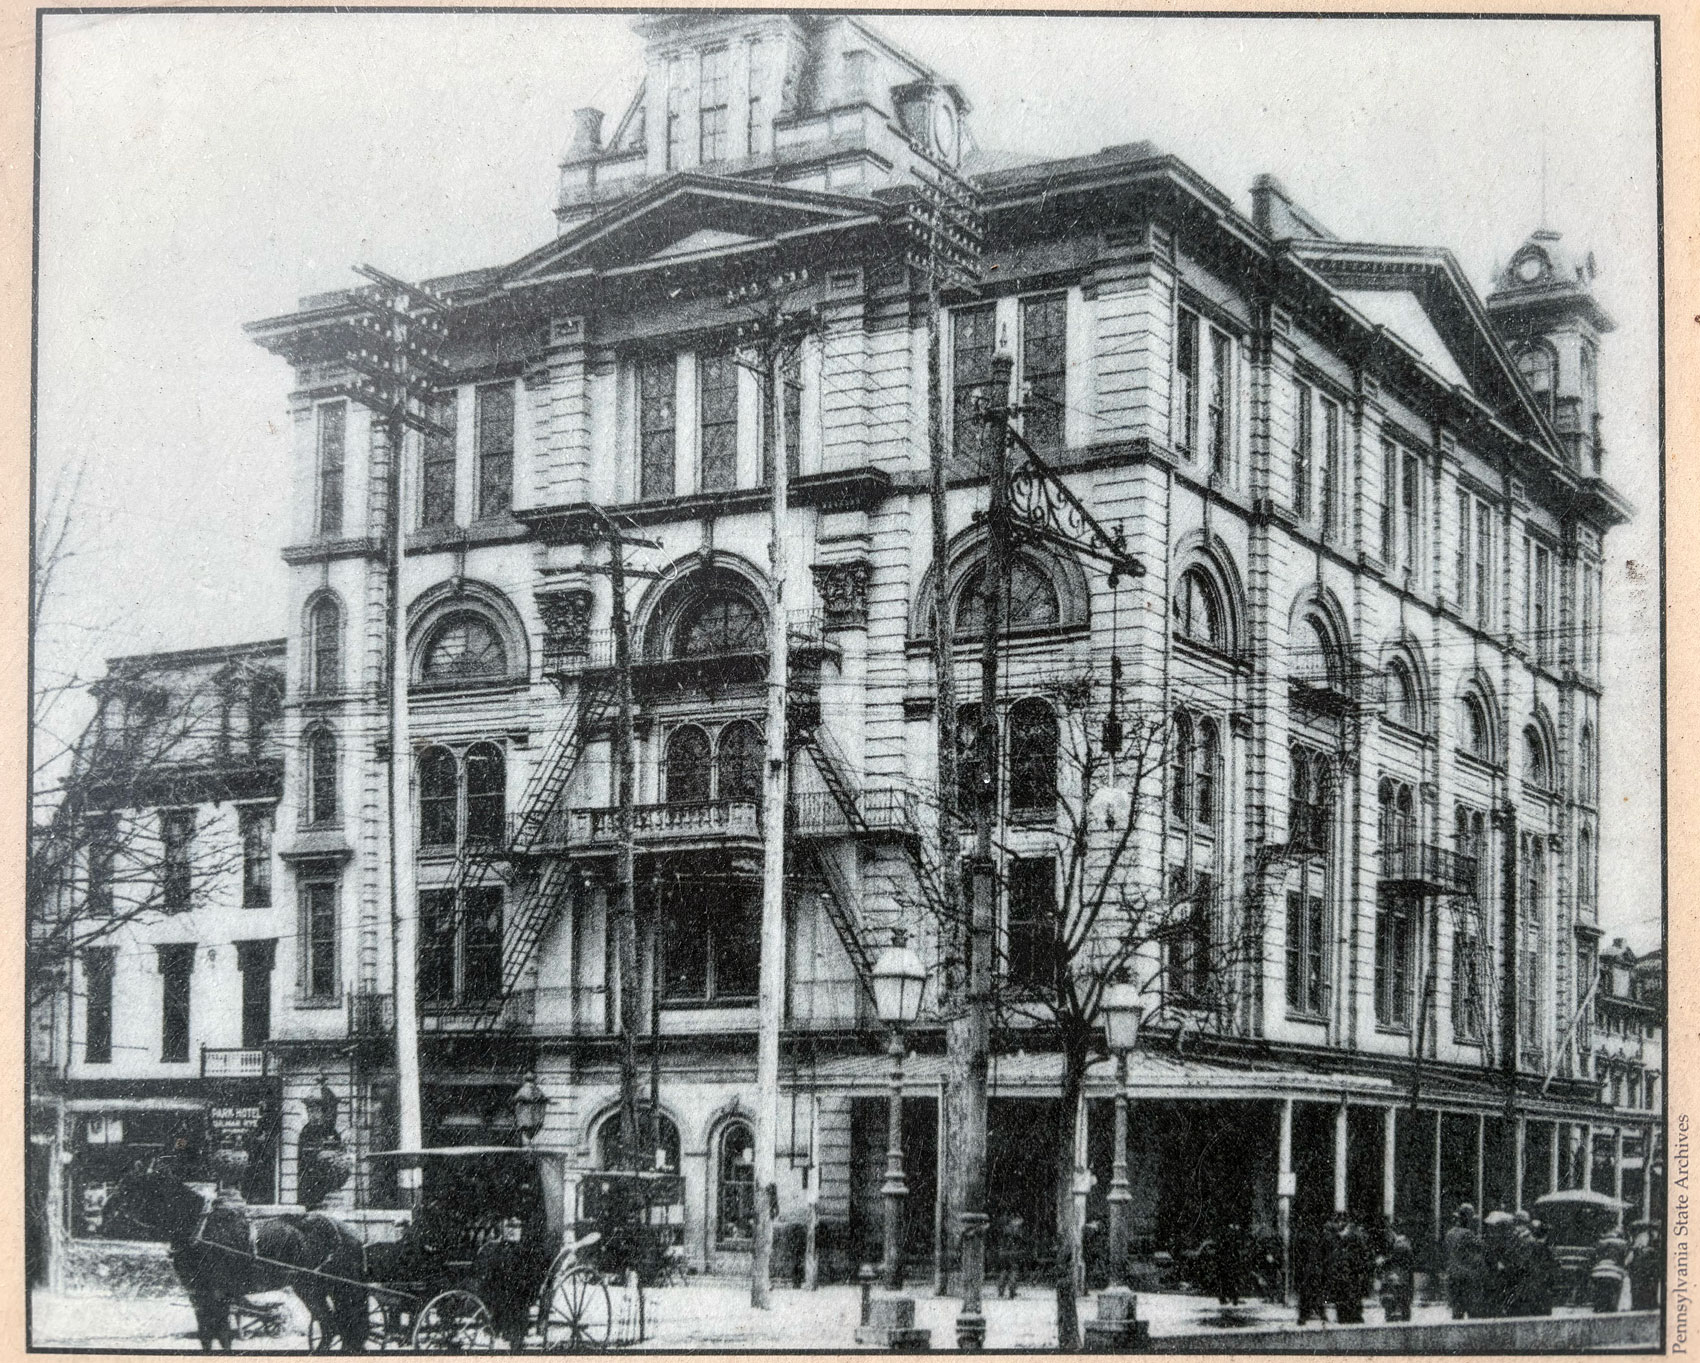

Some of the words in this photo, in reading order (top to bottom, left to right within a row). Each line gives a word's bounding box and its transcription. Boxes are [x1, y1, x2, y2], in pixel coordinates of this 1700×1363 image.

[236, 1107, 262, 1118] HOTEL
[1673, 1114, 1689, 1189] Archives
[1673, 1194, 1689, 1236] State
[1672, 1242, 1693, 1354] Pennsylvania
